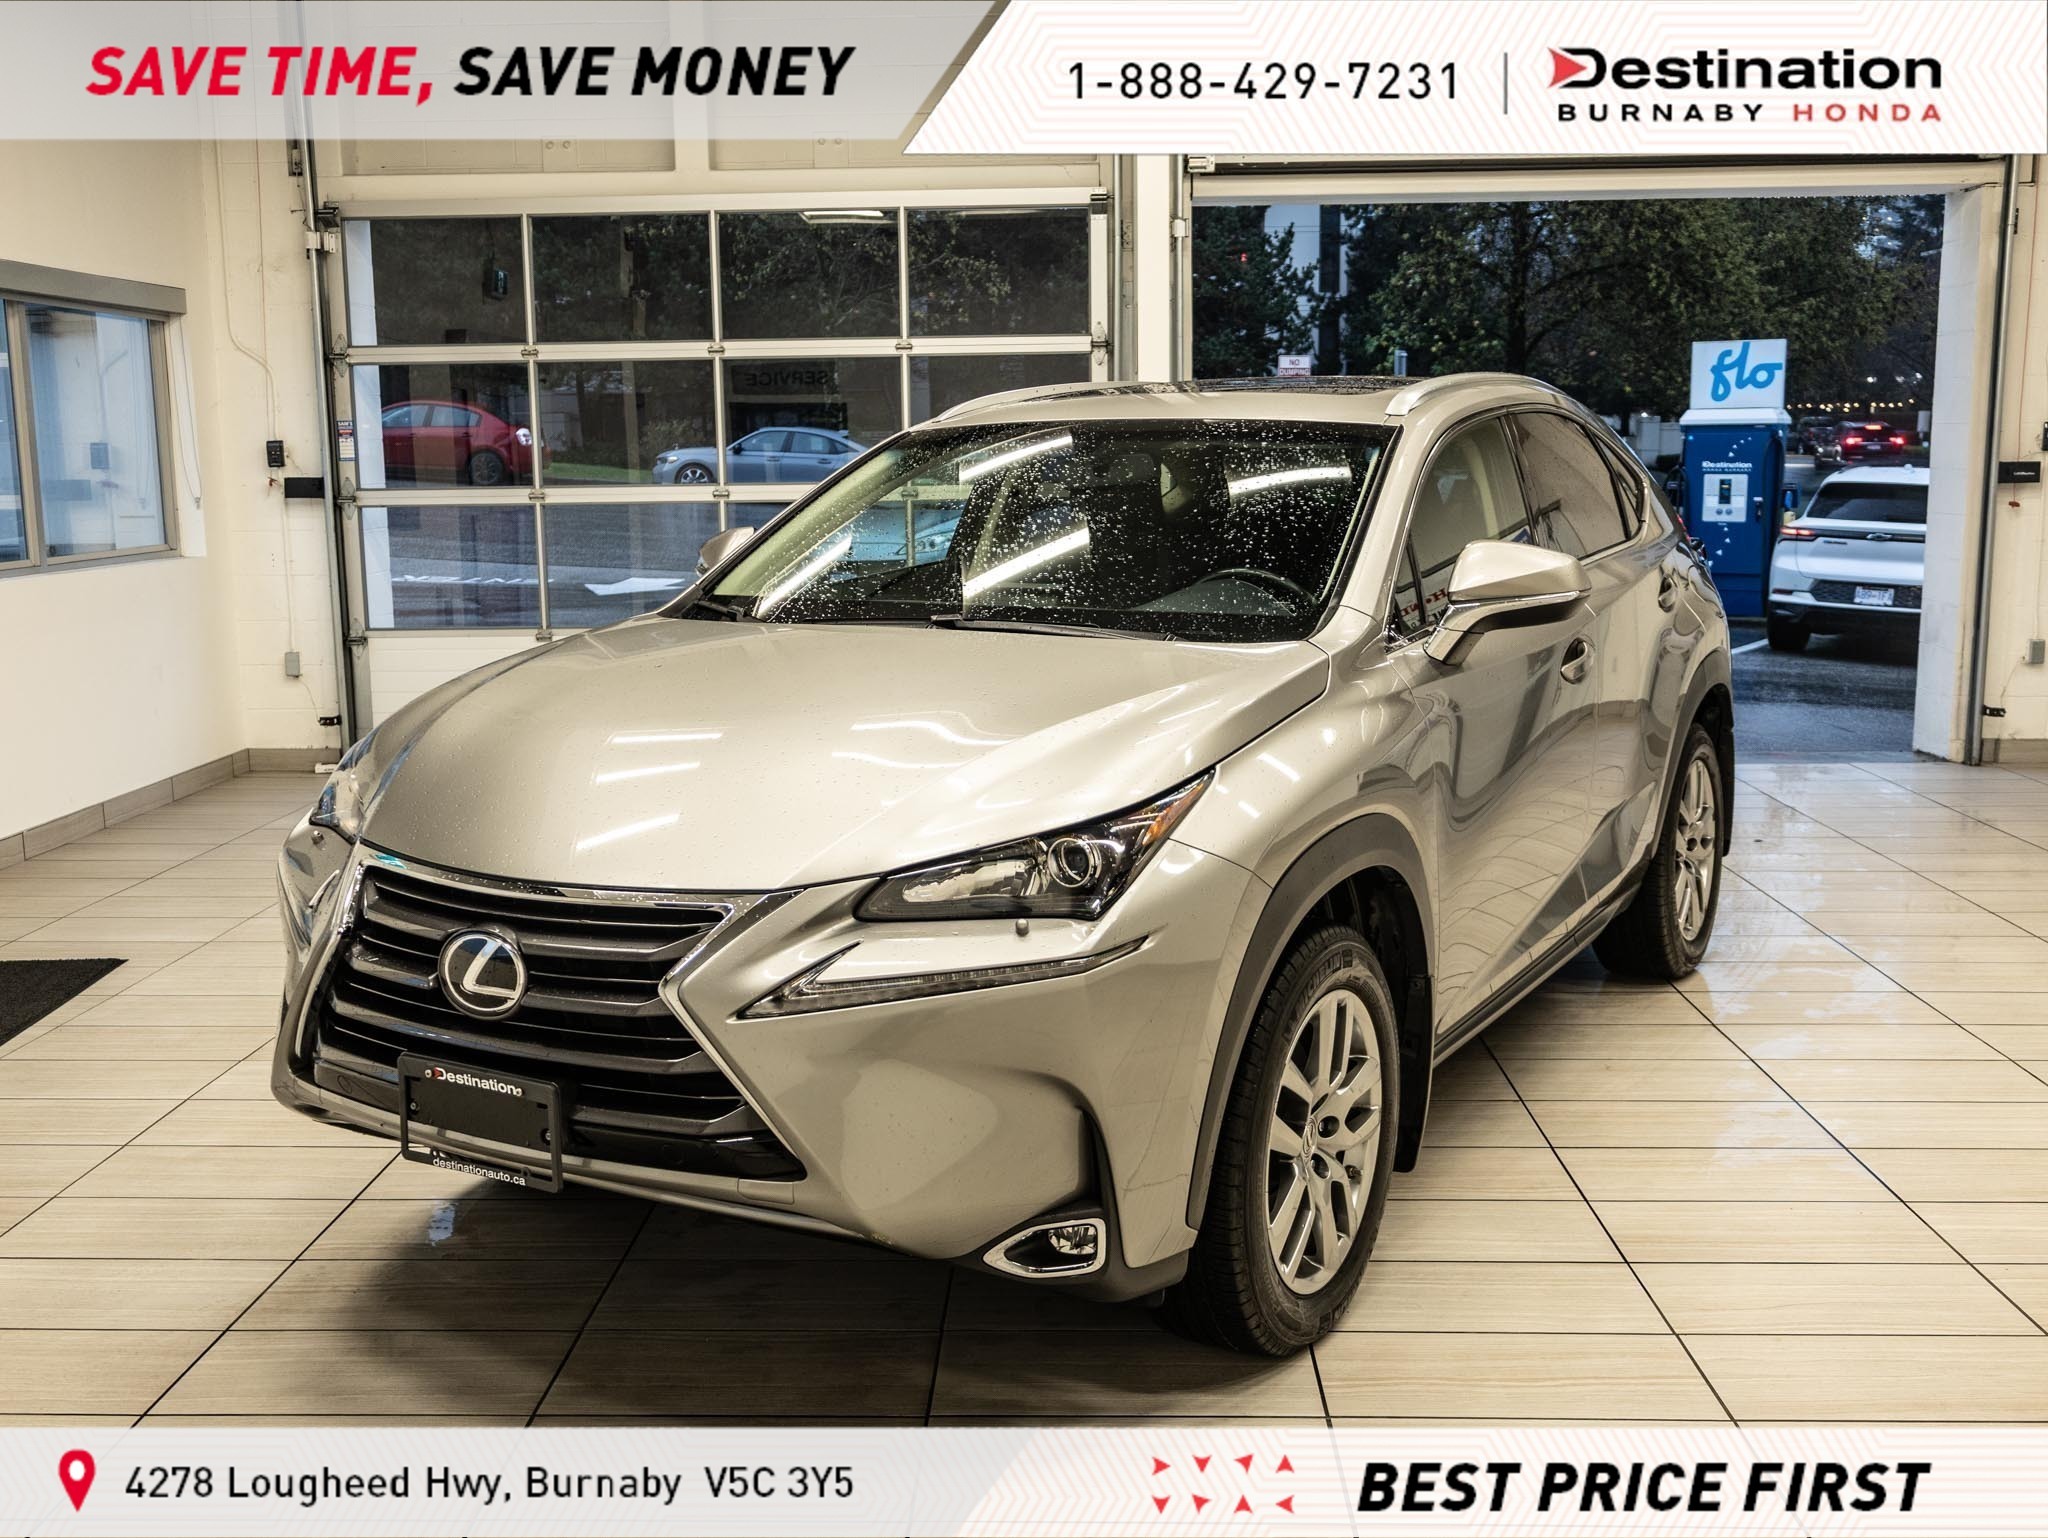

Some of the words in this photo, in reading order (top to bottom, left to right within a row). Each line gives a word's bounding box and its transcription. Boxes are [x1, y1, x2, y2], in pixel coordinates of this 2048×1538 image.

[1288, 358, 1300, 366] NO
[1710, 341, 1783, 402] flo
[434, 1067, 519, 1096] Destination
[432, 1157, 526, 1186] destinationauto.ca
